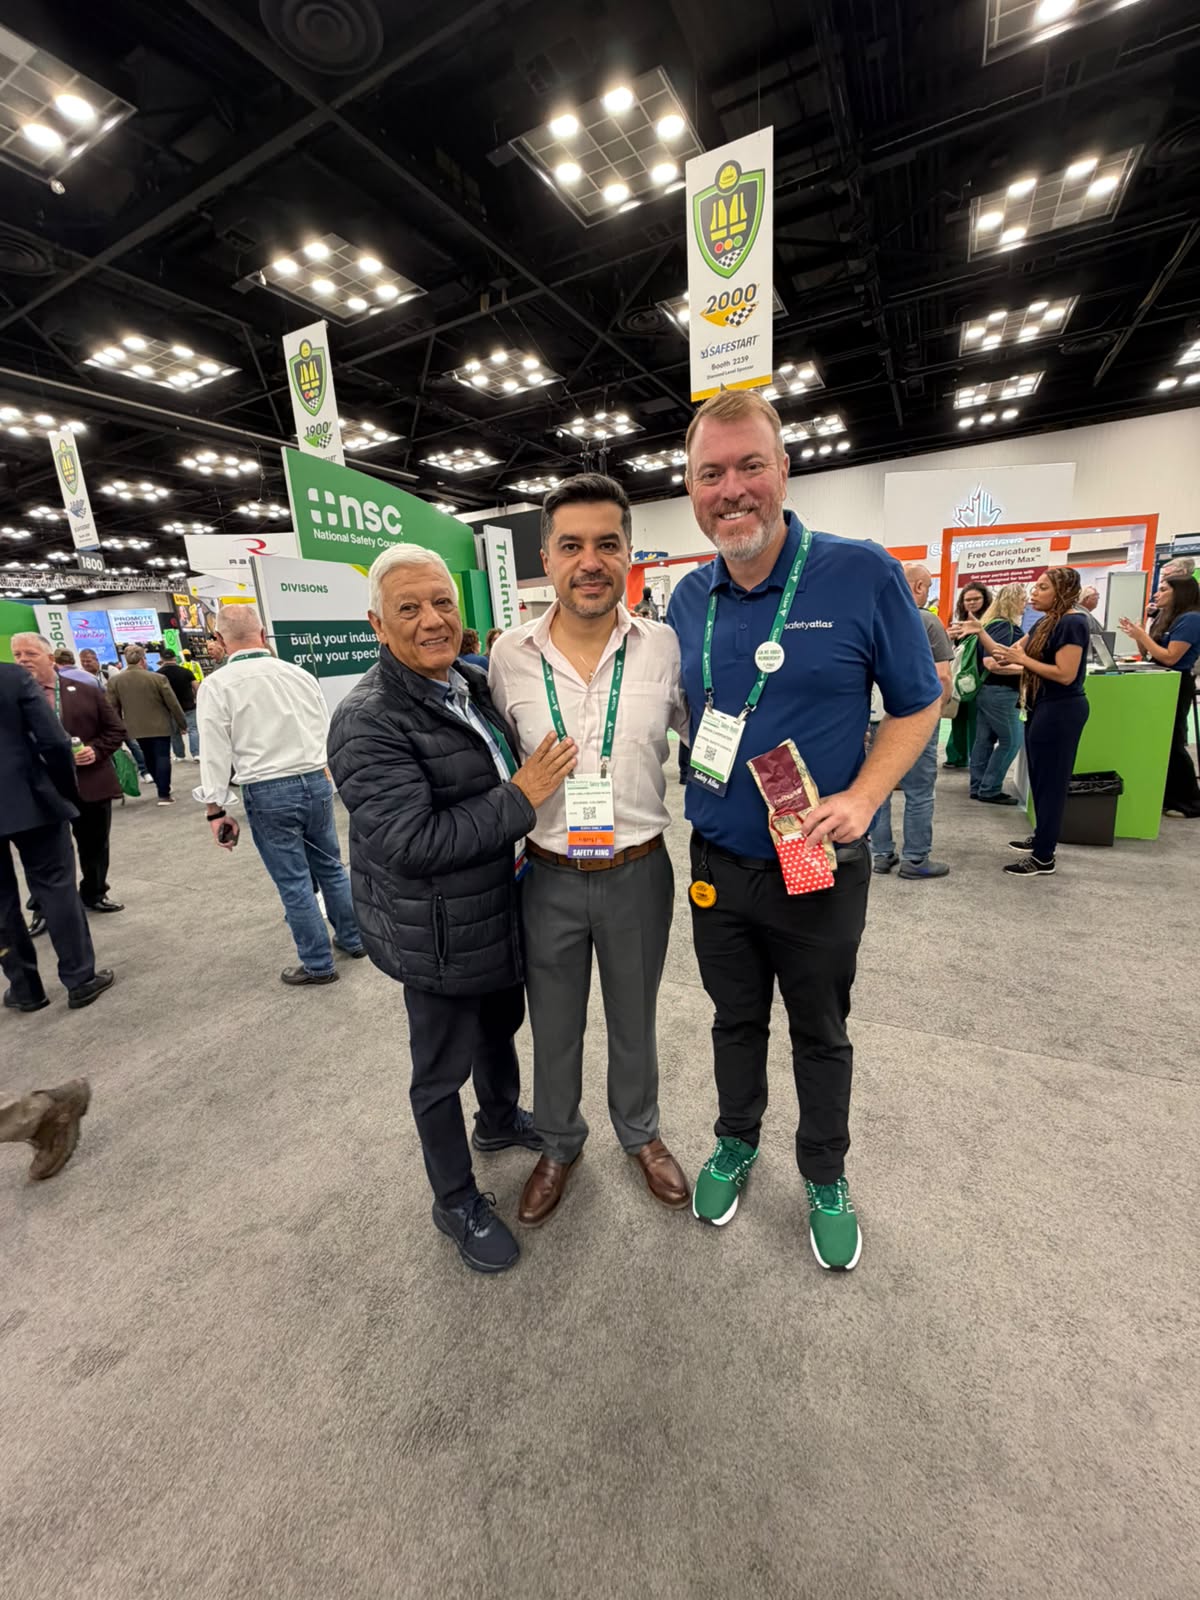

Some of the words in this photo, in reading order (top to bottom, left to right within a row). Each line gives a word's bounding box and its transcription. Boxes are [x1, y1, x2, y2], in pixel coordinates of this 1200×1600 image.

[705, 283, 757, 314] 2000
[709, 335, 759, 357] SAFESTART
[711, 360, 731, 370] Booth
[338, 493, 403, 536] nsc
[313, 528, 350, 543] National
[350, 534, 376, 548] Safety
[968, 551, 987, 560] Free
[989, 546, 1041, 557] Caricatures
[978, 557, 1016, 567] Dexterity
[280, 582, 329, 593] DIVISIONS
[784, 619, 833, 631] safetyatlas
[290, 633, 321, 645] Build
[322, 633, 348, 647] your
[349, 631, 380, 643] indus
[324, 651, 350, 664] your
[573, 849, 594, 857] SAFETY
[594, 849, 610, 857] KING
